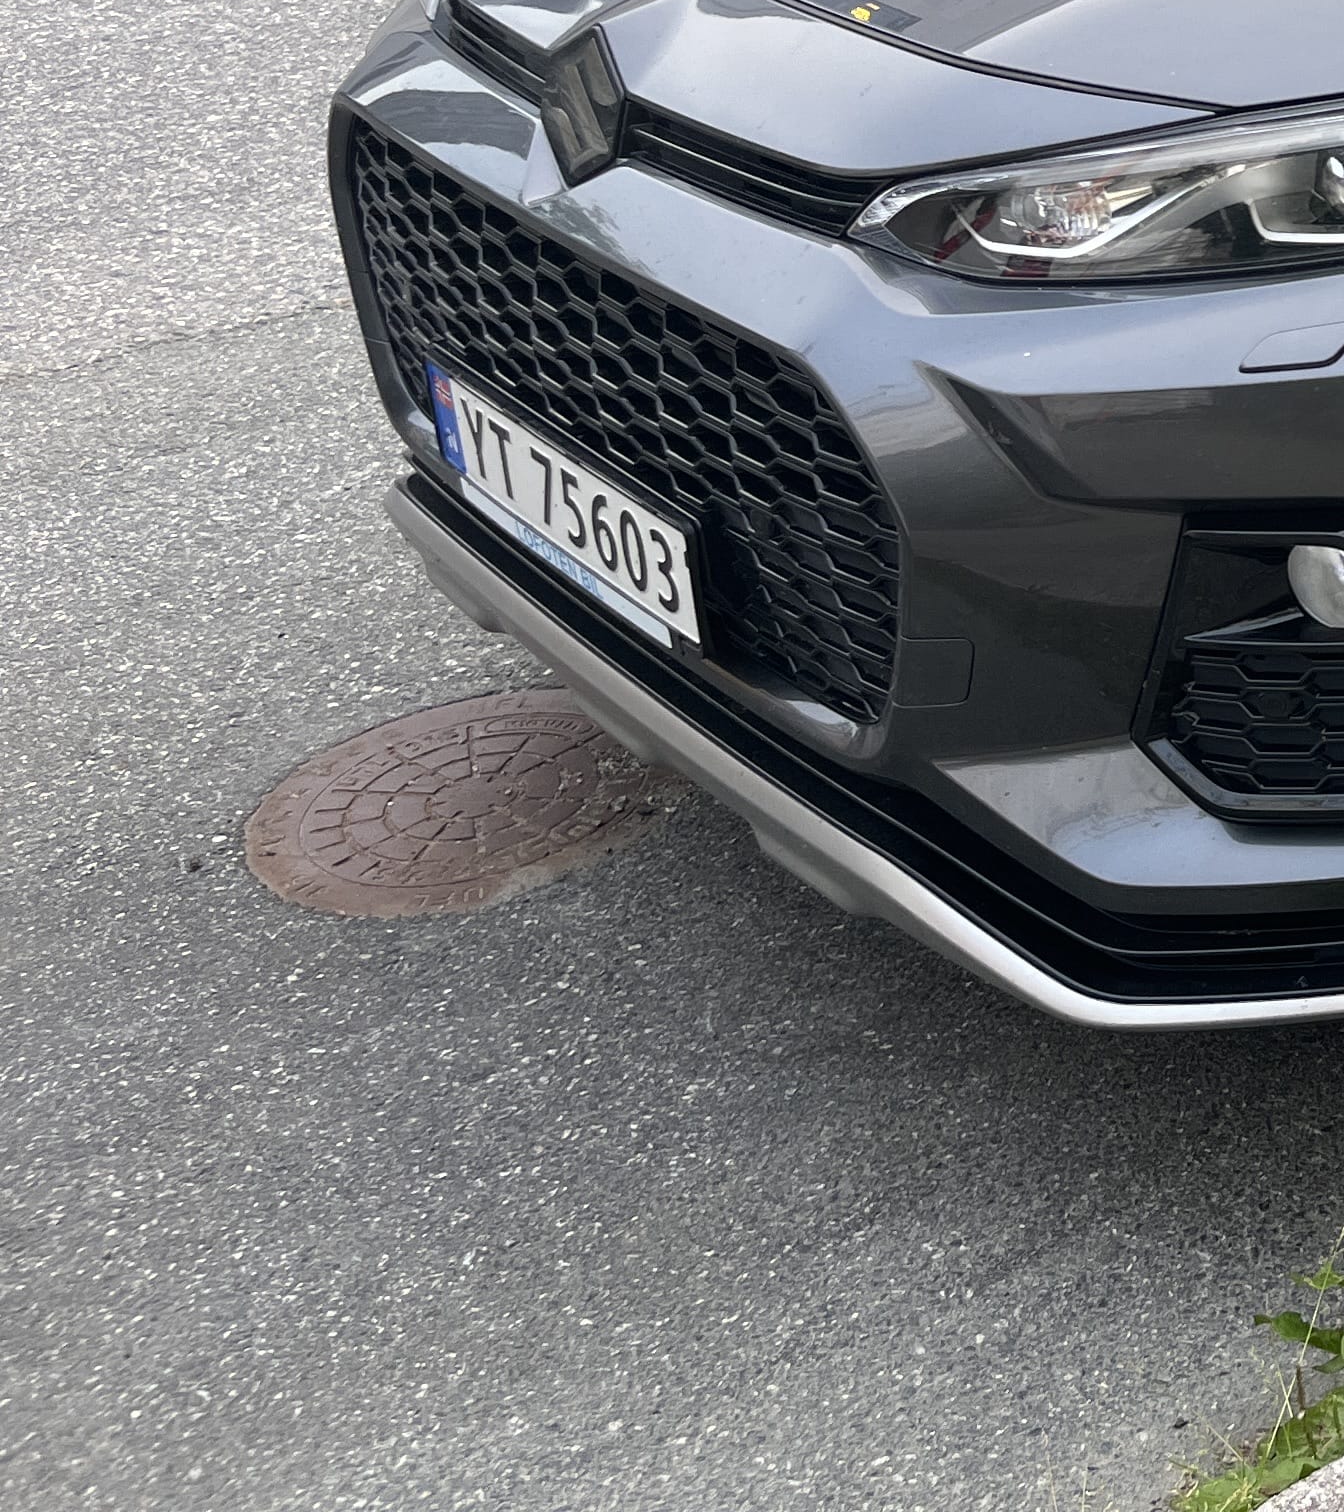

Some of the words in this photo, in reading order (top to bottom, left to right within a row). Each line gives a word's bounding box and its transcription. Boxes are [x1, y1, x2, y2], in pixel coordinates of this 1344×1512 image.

[460, 397, 514, 501] YT
[530, 446, 681, 614] 75603
[515, 520, 579, 581] LOFOTEN
